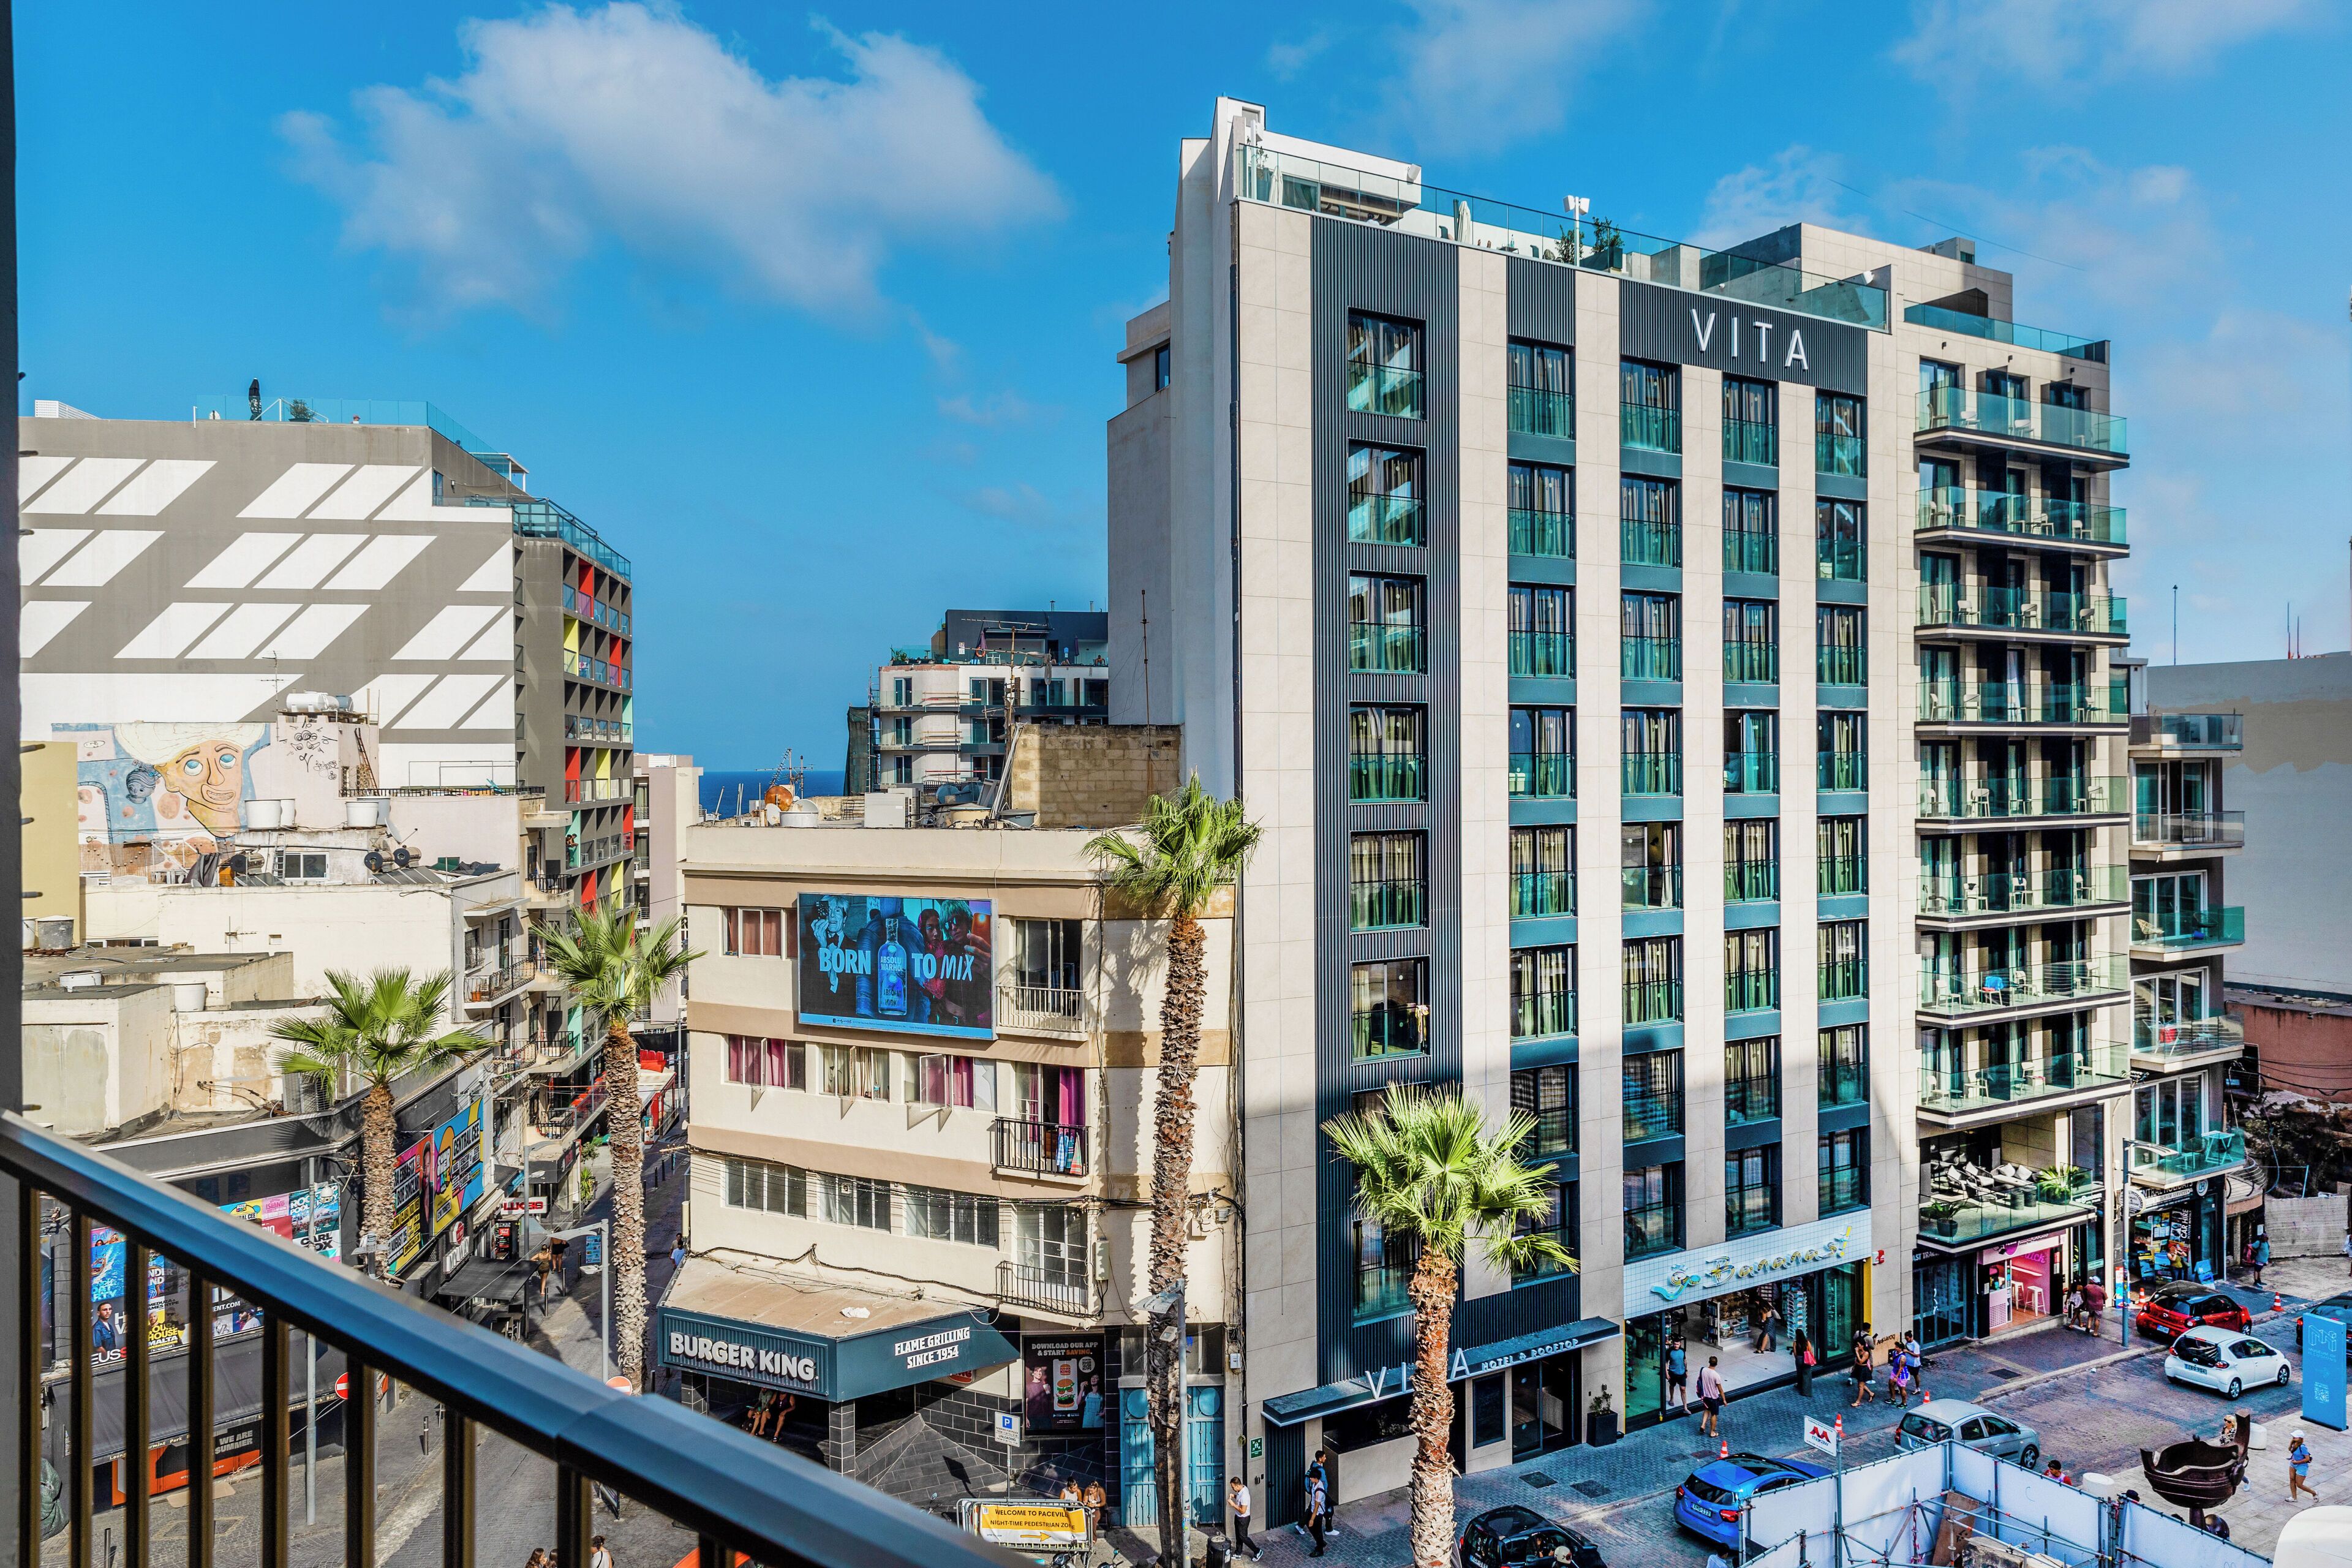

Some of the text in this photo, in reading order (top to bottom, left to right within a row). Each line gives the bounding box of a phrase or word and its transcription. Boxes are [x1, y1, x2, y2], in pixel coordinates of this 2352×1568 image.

[1690, 309, 1809, 371] VITA
[820, 948, 975, 982] BORN TO MIX
[454, 1128, 471, 1157] CENTRAL
[2143, 1188, 2163, 1199] NTRAL
[1703, 1225, 1853, 1288] Bananas!
[1912, 1253, 1921, 1262] AST
[148, 1268, 173, 1278] NDER
[213, 1300, 241, 1312] ENT.COM
[148, 1327, 179, 1341] HOUSE
[148, 1336, 178, 1346] MALTA
[895, 1327, 970, 1356] FLAME GRILLING
[670, 1332, 816, 1381] BURGER KING
[907, 1344, 959, 1369] SINCE 1954
[1365, 1338, 1579, 1400] VIA HOTEL & ROOFTOP
[214, 1438, 253, 1455] SUMMER
[219, 1430, 253, 1446] WE ARE
[1061, 1521, 1076, 1530] ZONE
